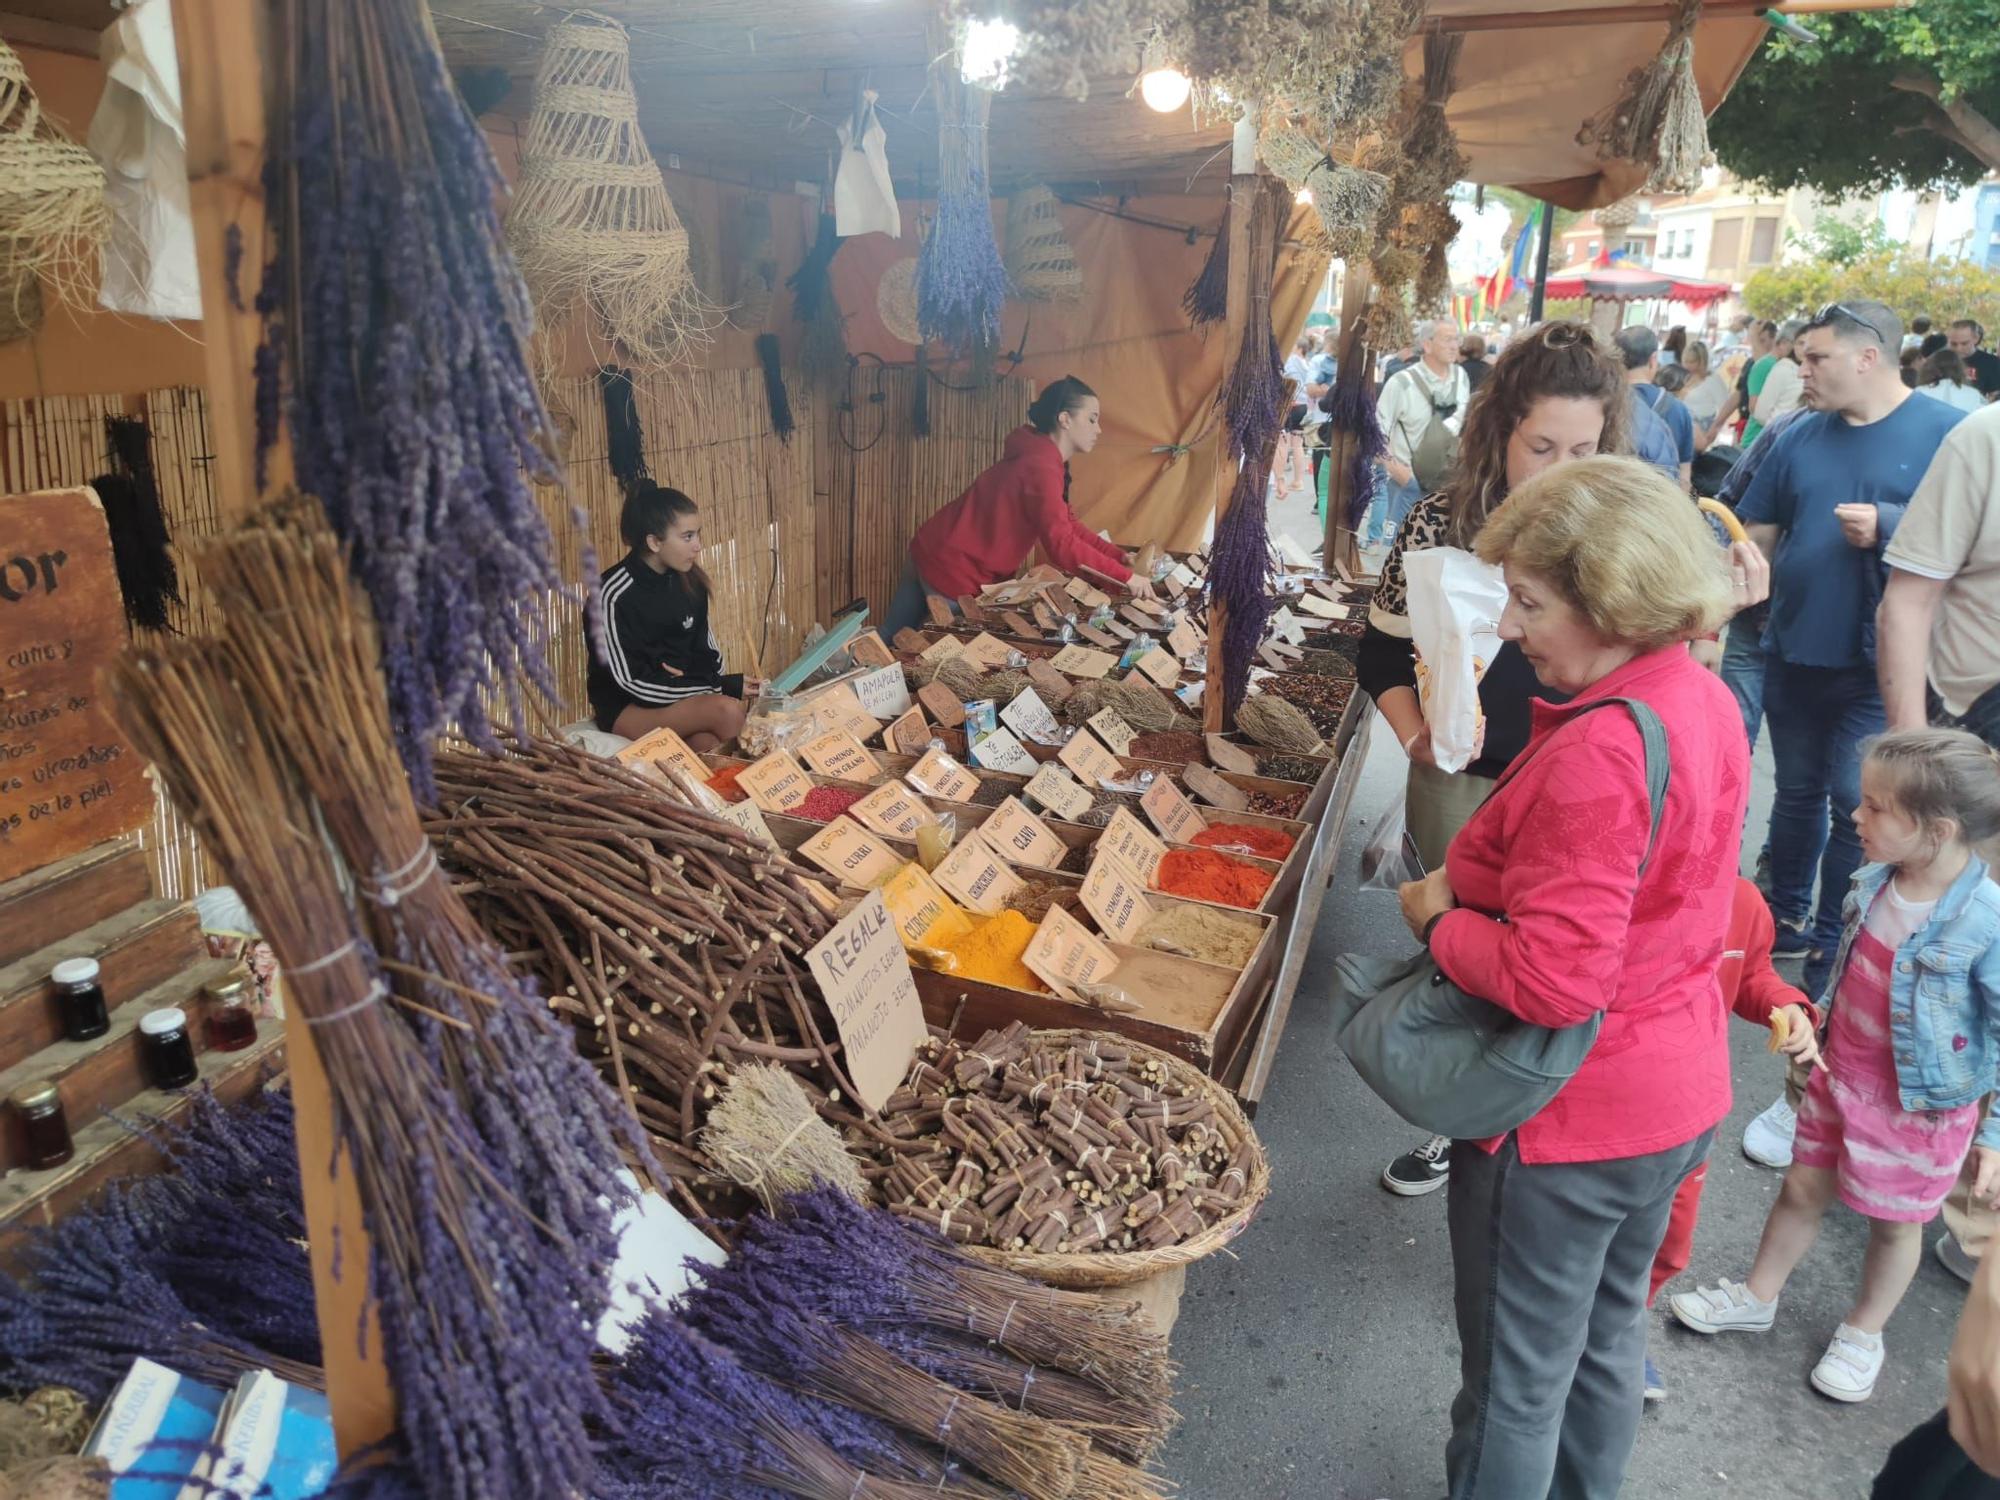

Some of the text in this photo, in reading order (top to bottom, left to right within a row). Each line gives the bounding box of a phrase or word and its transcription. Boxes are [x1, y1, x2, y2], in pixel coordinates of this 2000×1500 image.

[862, 668, 901, 695] AMAPOLA
[824, 746, 856, 768] COMINOS
[843, 756, 866, 773] GRANO
[765, 772, 801, 800] PIMIENTA
[779, 790, 802, 808] ROSA
[945, 779, 965, 799] NEGRA
[878, 799, 911, 824] PIMIENTA
[1012, 825, 1038, 851] CLAVO
[843, 844, 873, 870] CURRI
[1105, 882, 1125, 918] COMINOS
[1061, 941, 1085, 976] CANELA
